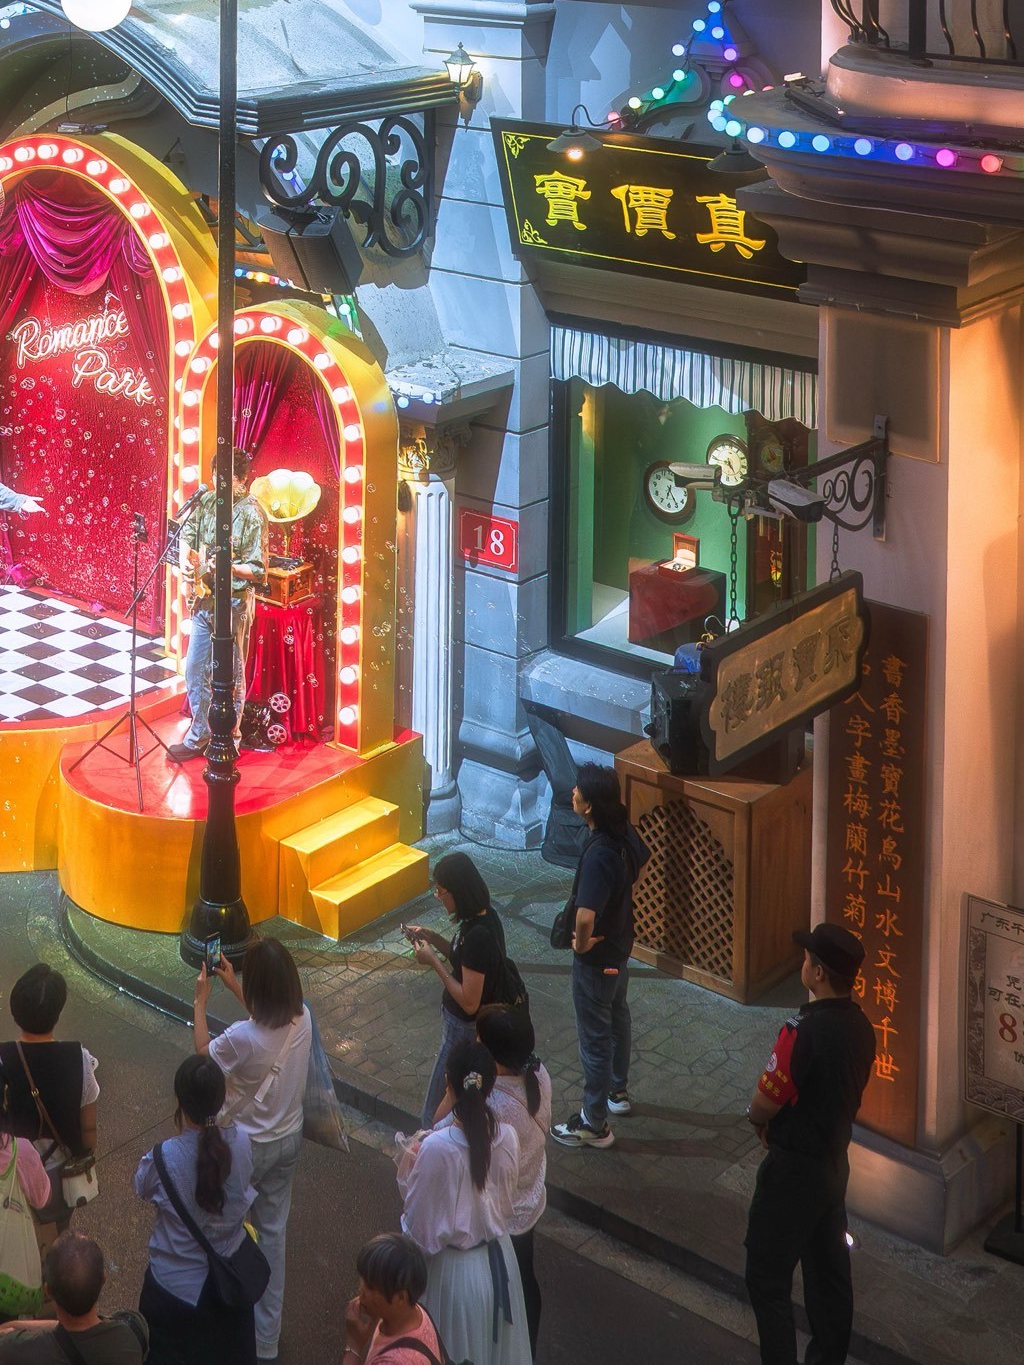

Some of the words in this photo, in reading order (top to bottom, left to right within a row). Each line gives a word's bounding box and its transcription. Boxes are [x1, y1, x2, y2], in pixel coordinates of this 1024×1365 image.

[12, 308, 130, 369] Romance
[72, 346, 156, 406] Park
[474, 524, 505, 556] 18
